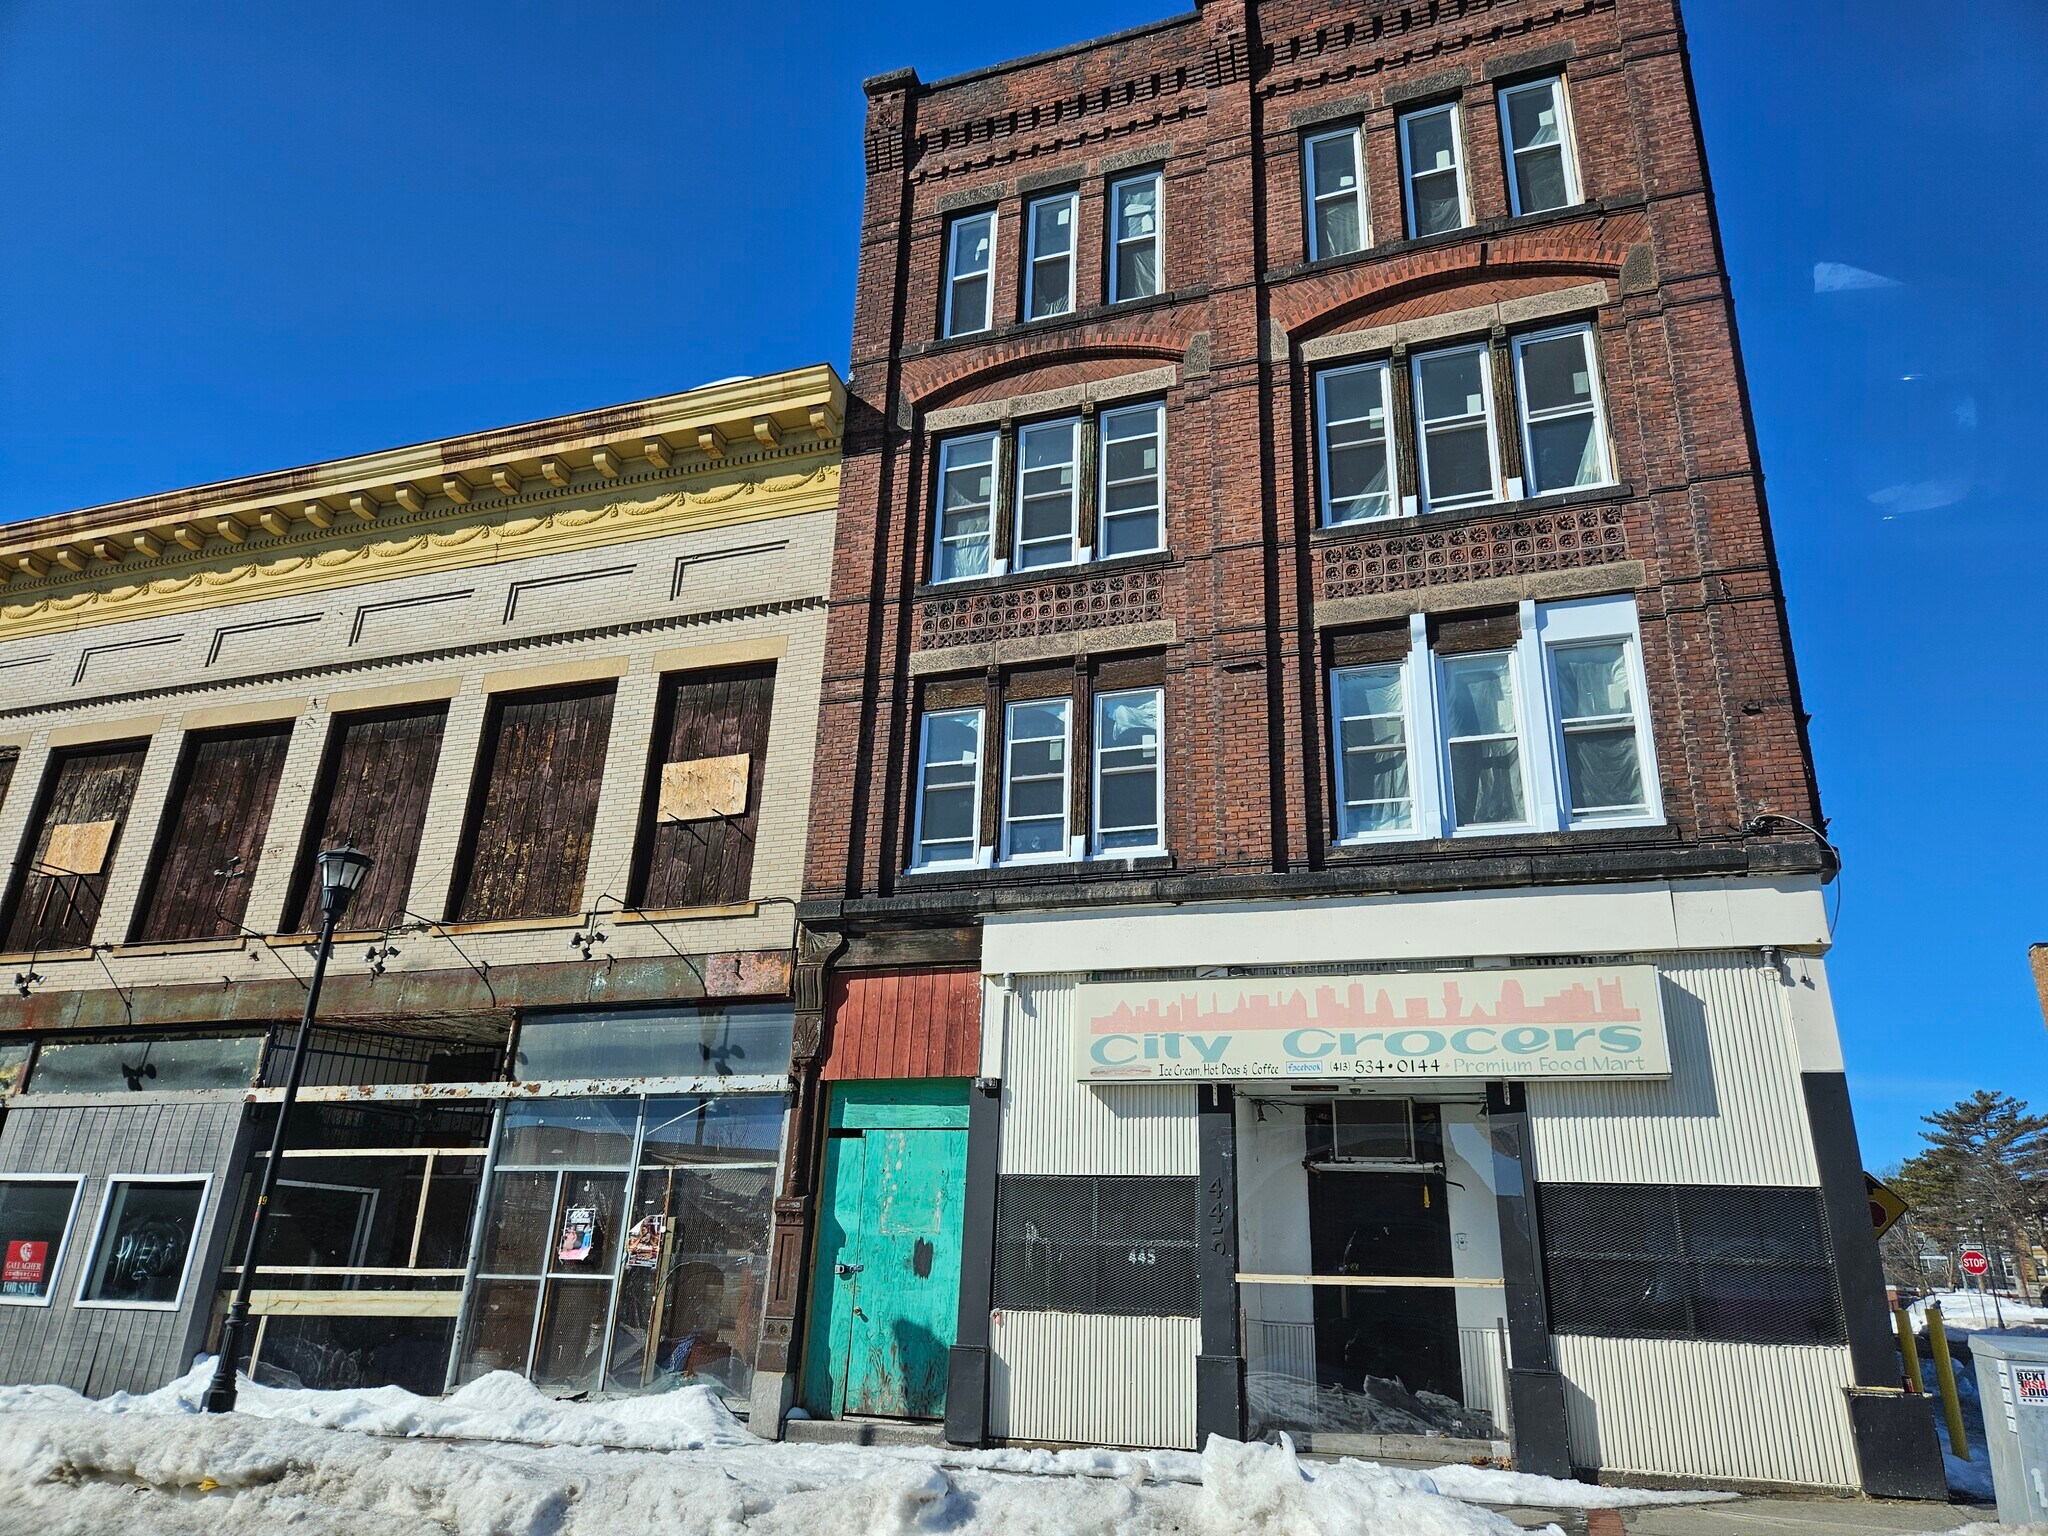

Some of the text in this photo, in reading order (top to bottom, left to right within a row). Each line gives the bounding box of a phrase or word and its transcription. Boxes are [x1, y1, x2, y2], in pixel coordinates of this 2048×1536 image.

[1090, 1025, 1642, 1066] City Grocers
[1158, 1063, 1172, 1077] Ice
[1203, 1063, 1219, 1076] Hot
[1243, 1063, 1248, 1076] &
[1251, 1061, 1279, 1075] Coffee
[1287, 1063, 1321, 1072] facebook
[1329, 1060, 1351, 1073] (413)
[1453, 1054, 1646, 1074] Premium Food Mart
[1963, 1258, 1985, 1268] STOP
[2, 1281, 38, 1293] FOR SALE
